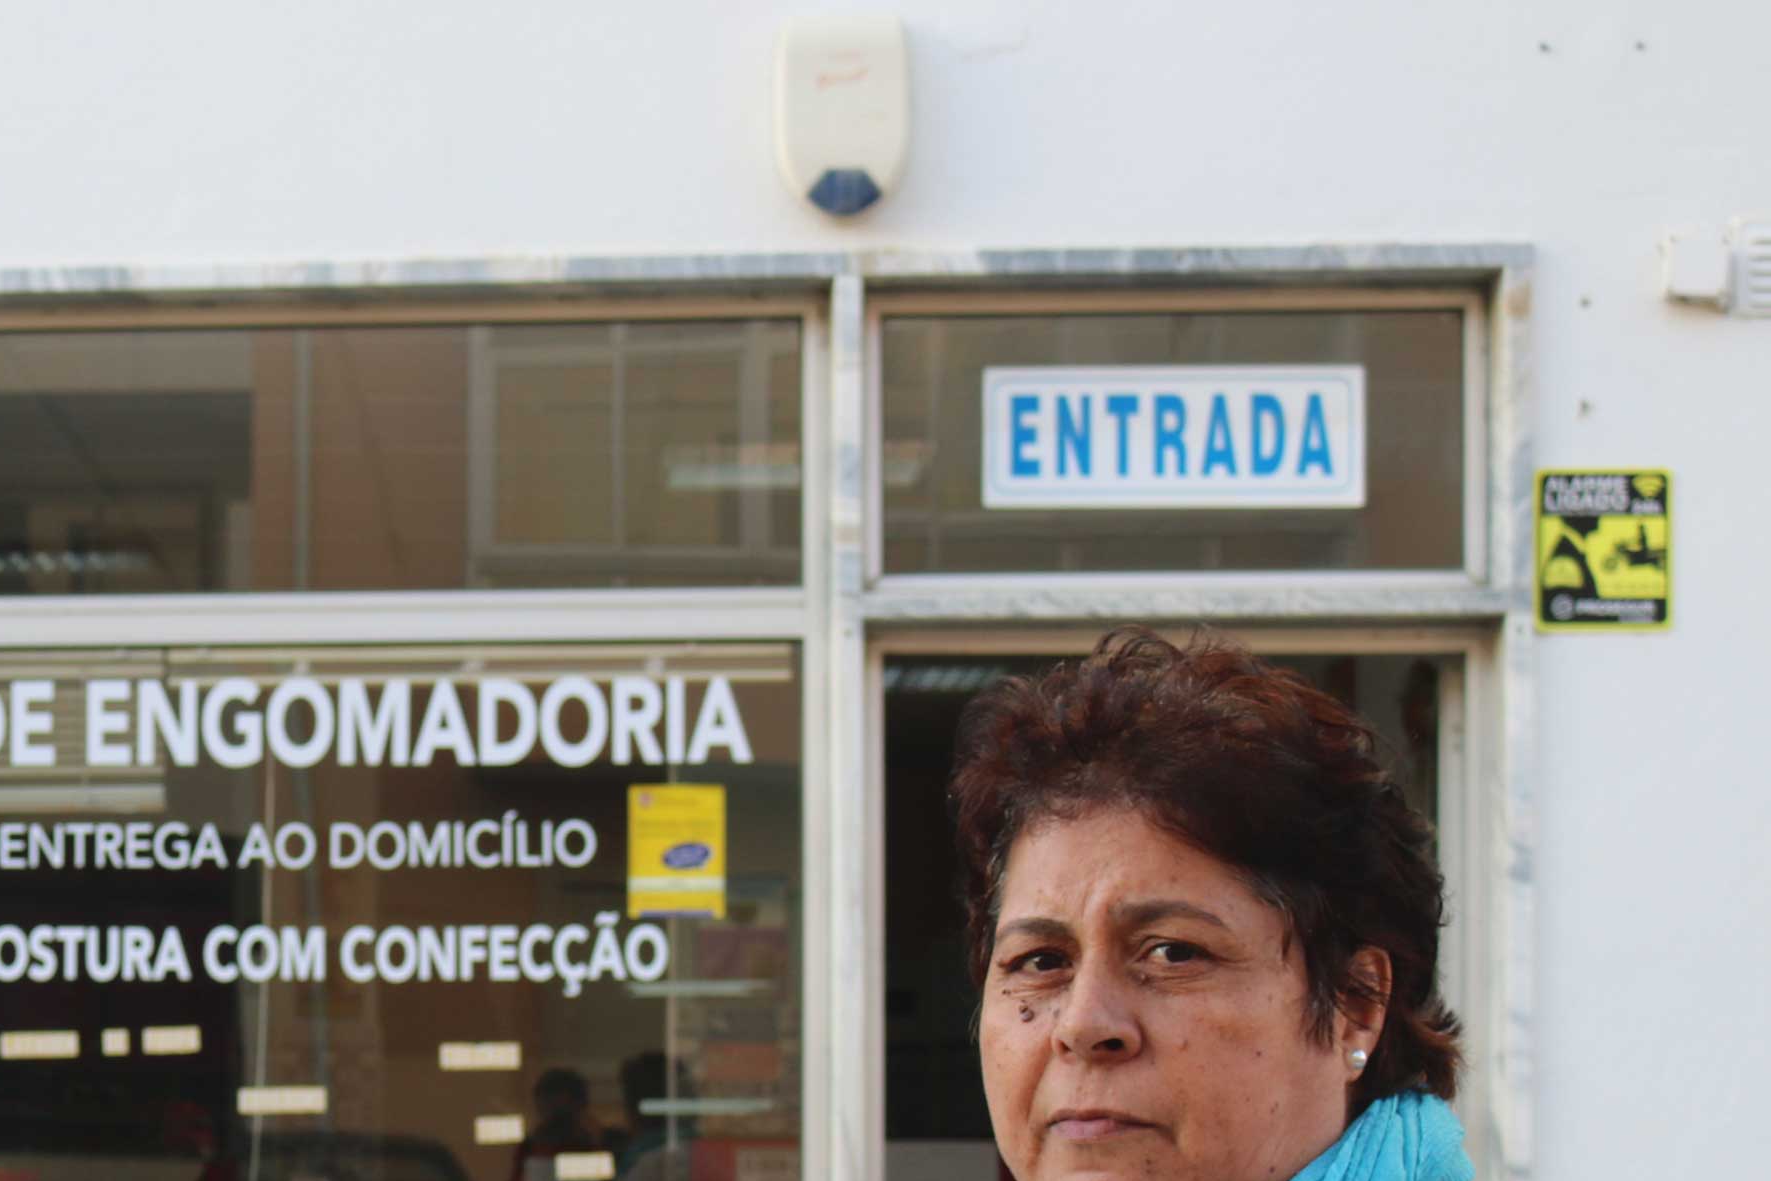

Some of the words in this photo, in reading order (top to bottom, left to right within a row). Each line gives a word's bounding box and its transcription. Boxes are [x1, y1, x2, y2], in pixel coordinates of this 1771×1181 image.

[1009, 393, 1334, 477] ENTRADA
[84, 674, 754, 768] ENGOMADORIA
[237, 821, 317, 870] AO
[328, 810, 598, 869] DOMICÍLIO
[202, 924, 327, 983] COM
[339, 910, 671, 998] CONFECÇÃO
